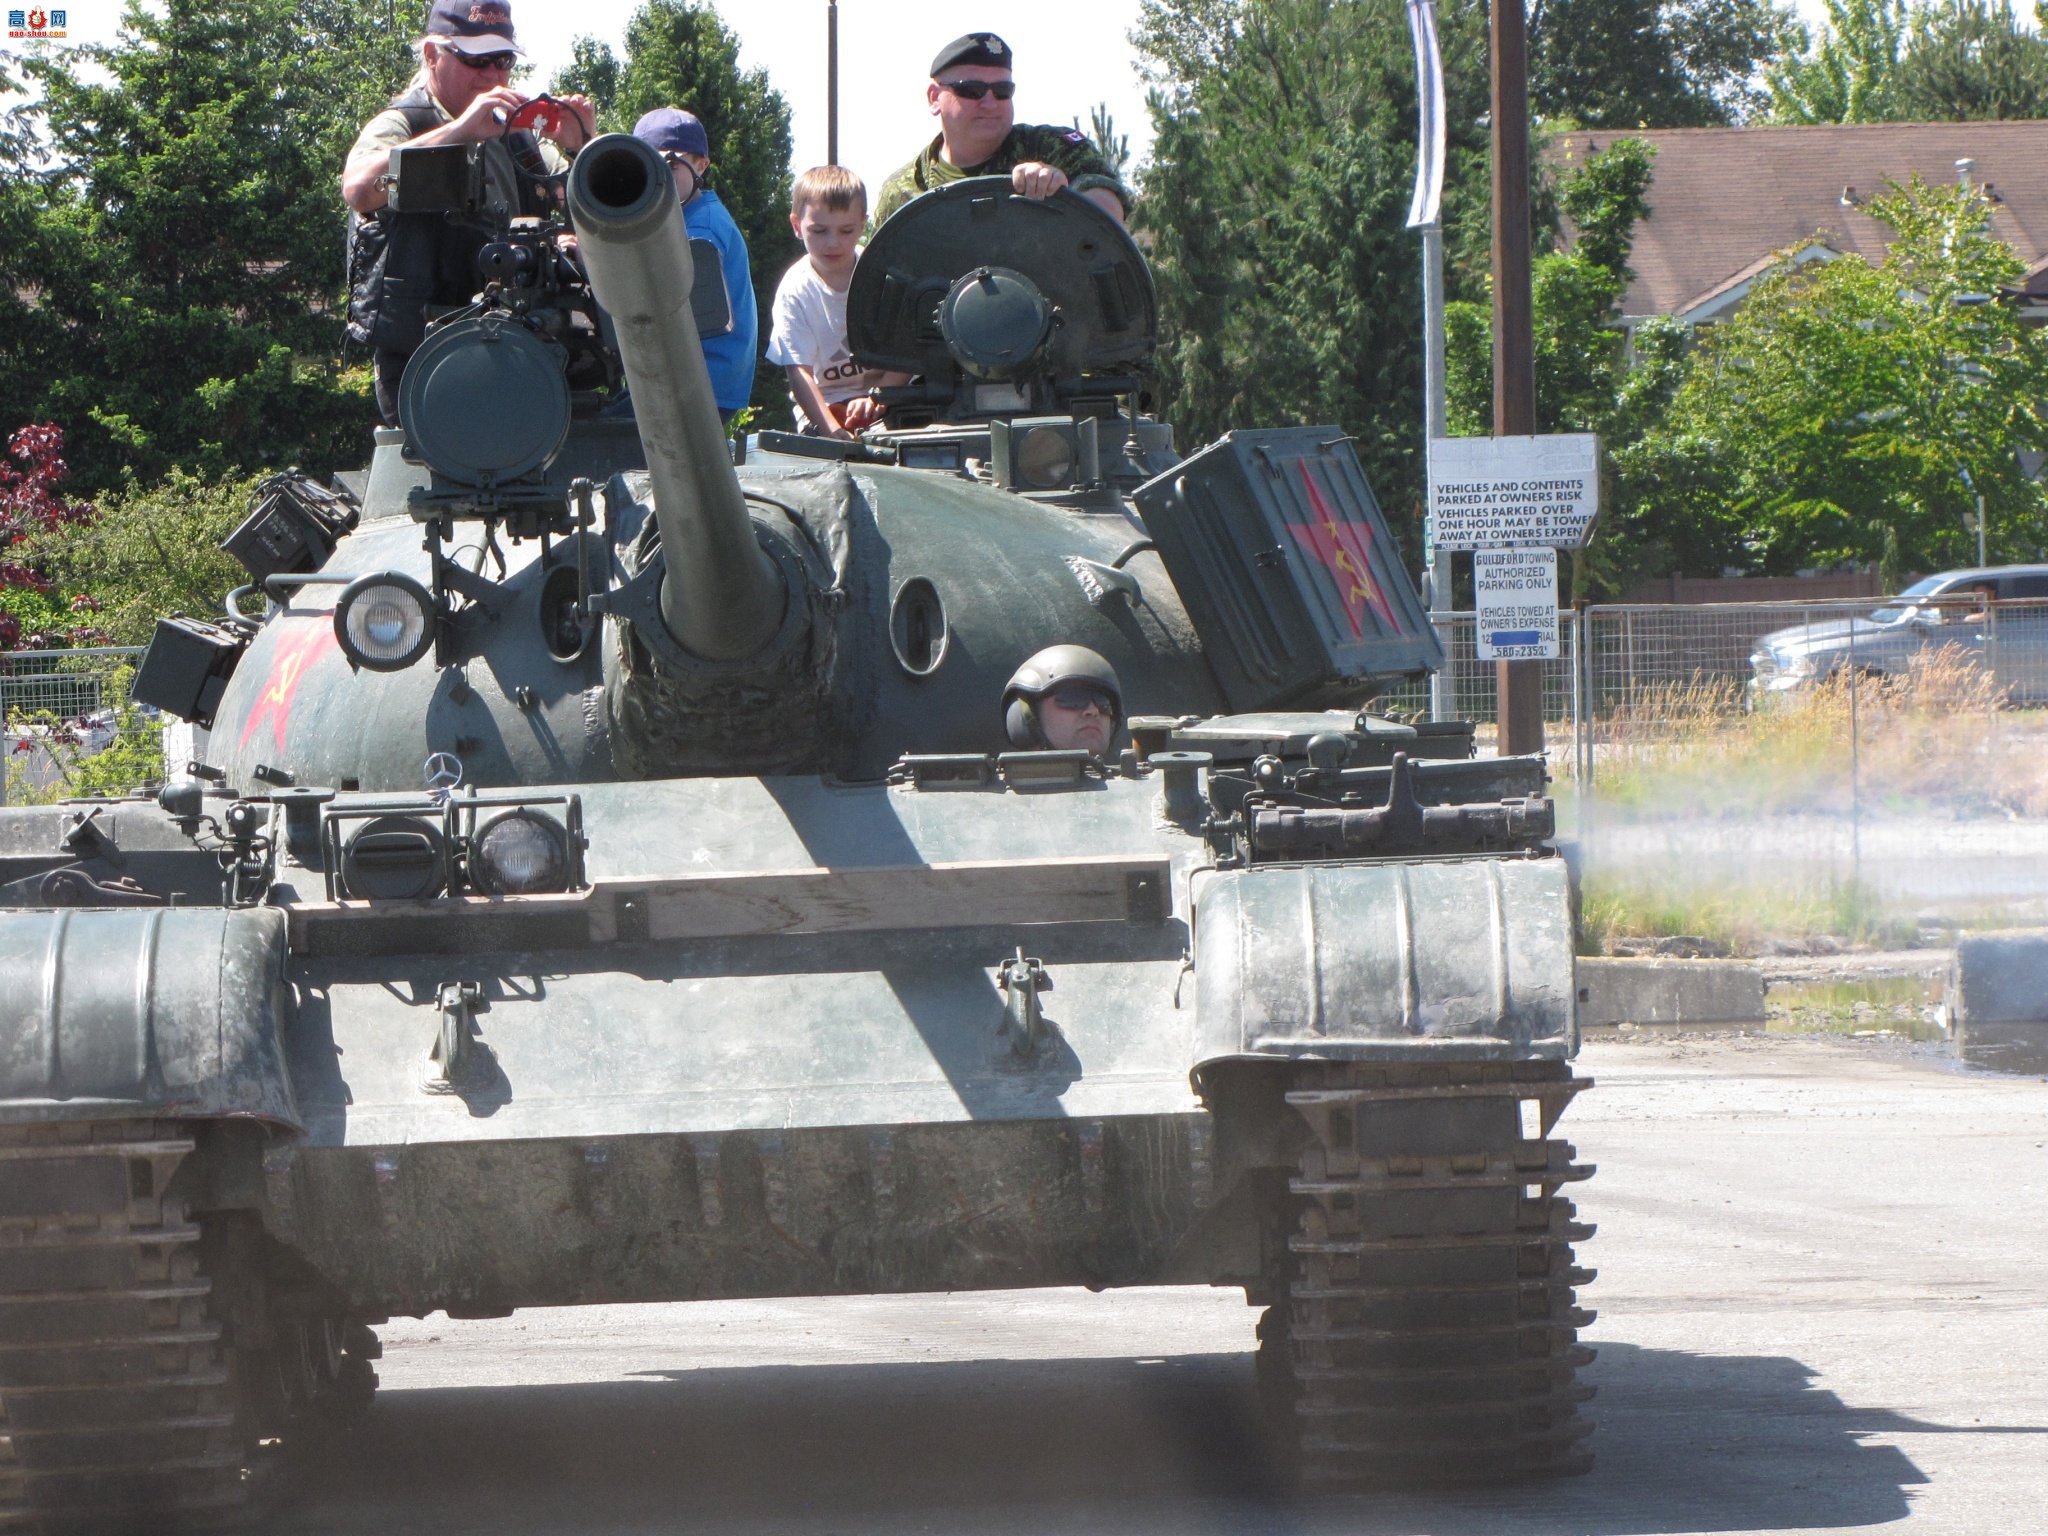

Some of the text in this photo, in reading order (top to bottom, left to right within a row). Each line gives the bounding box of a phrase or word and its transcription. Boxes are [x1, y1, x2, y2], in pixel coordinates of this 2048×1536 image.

[824, 357, 870, 380] adi
[1437, 480, 1583, 494] VEHICLES AND CONTENTS
[1437, 491, 1583, 505] PARKED AT OWNERS RISK
[1438, 505, 1574, 519] VEHICLES PARKED OVER
[1438, 515, 1592, 530] ONE HOUR MAY BE TOWE
[1439, 526, 1583, 541] AWAY AT OWNERS EXPEN
[1476, 552, 1555, 566] GUILDFORD TOWING
[1485, 566, 1545, 579] AUTHORIZED
[1478, 578, 1552, 591] PARKING ONLY
[1480, 605, 1554, 617] VEHICLES TOWED AT
[1480, 617, 1555, 629] OWNER'S EXPENSE
[1482, 634, 1492, 644] 12
